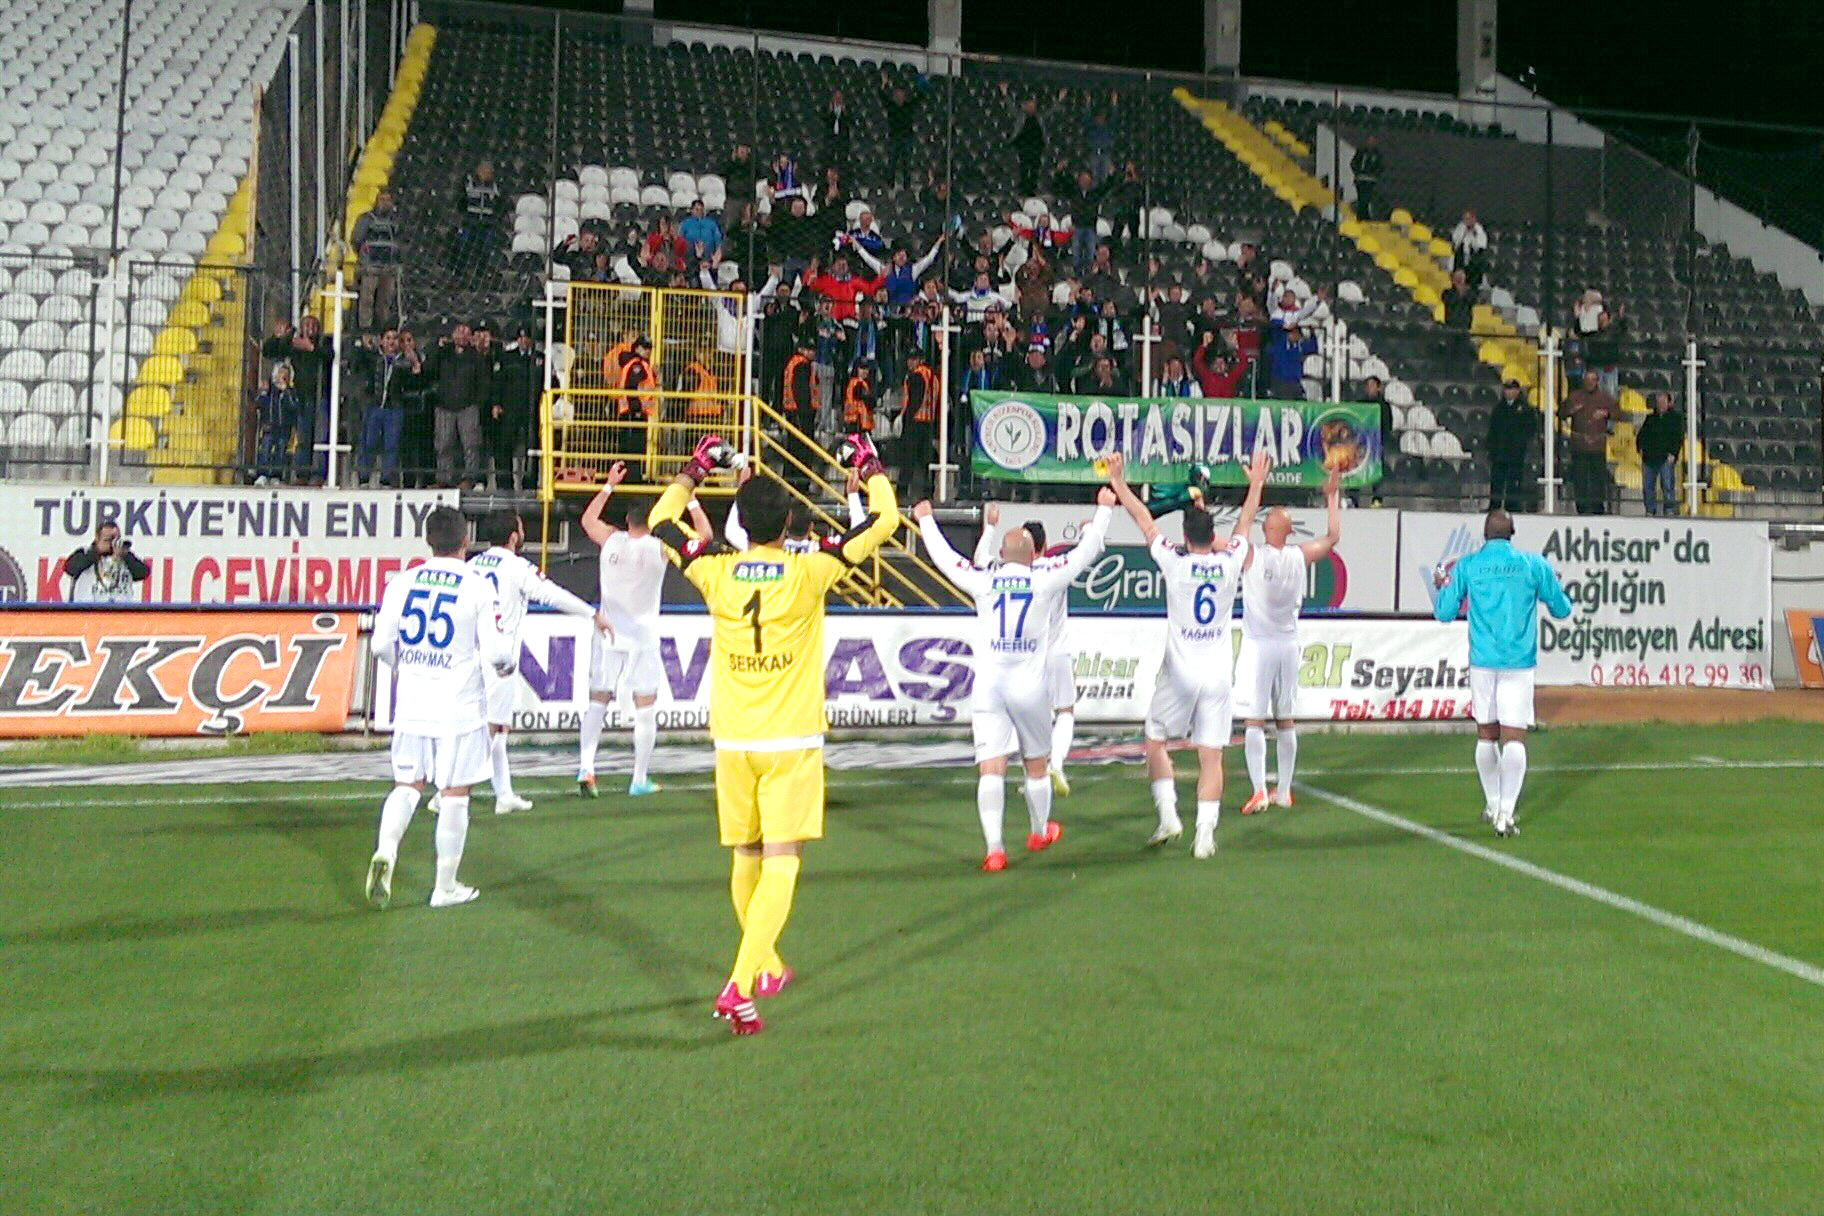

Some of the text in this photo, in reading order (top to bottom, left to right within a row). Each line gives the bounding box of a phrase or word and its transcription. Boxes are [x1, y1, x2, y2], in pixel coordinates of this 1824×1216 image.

[1056, 401, 1303, 468] ROTASIZLAR
[34, 490, 444, 538] TÜRKİYE'NİN EN İY
[1541, 526, 1711, 564] Akhisar'da
[190, 540, 427, 604] ÇEVİRME
[1562, 569, 1666, 614] ağlığın
[399, 588, 459, 649] 55
[742, 588, 762, 654] 1
[992, 592, 1033, 639] 17
[1194, 583, 1216, 625] 6
[1540, 616, 1764, 661] Değişmeyen Adresi
[729, 651, 793, 673] SERKAN
[1590, 663, 1763, 686] 0 236 412 99 30
